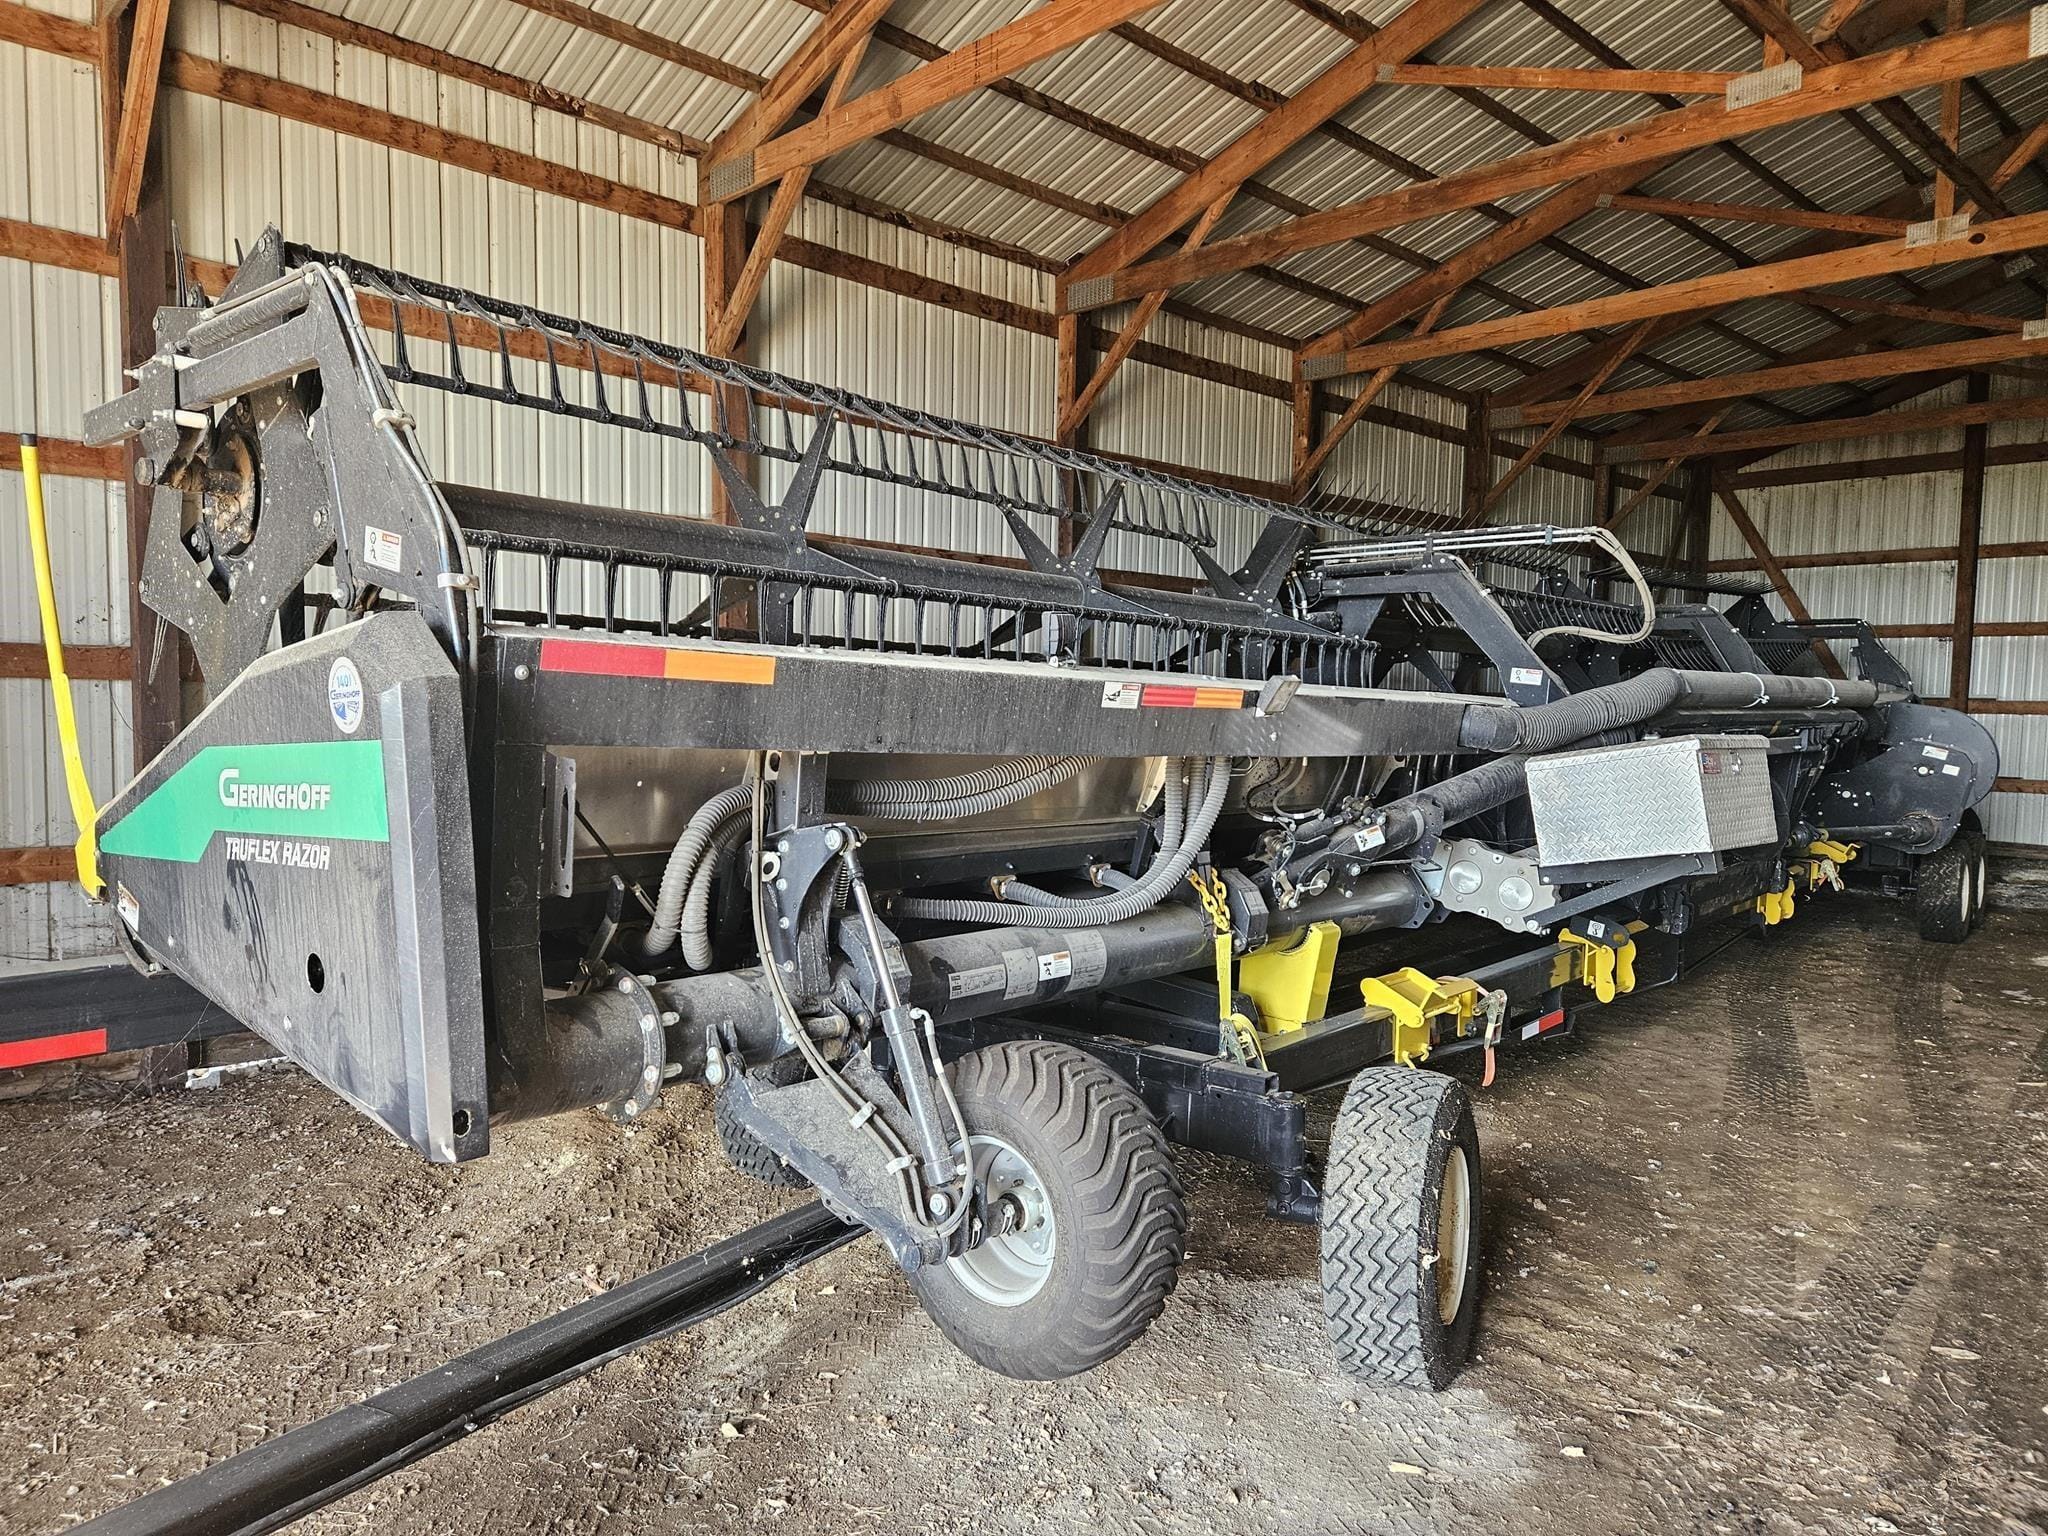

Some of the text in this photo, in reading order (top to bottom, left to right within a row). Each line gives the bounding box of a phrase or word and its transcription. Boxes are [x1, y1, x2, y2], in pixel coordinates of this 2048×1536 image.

[219, 768, 331, 811] GERINGHOFF
[225, 837, 331, 871] TRUFLEX RAZOR
